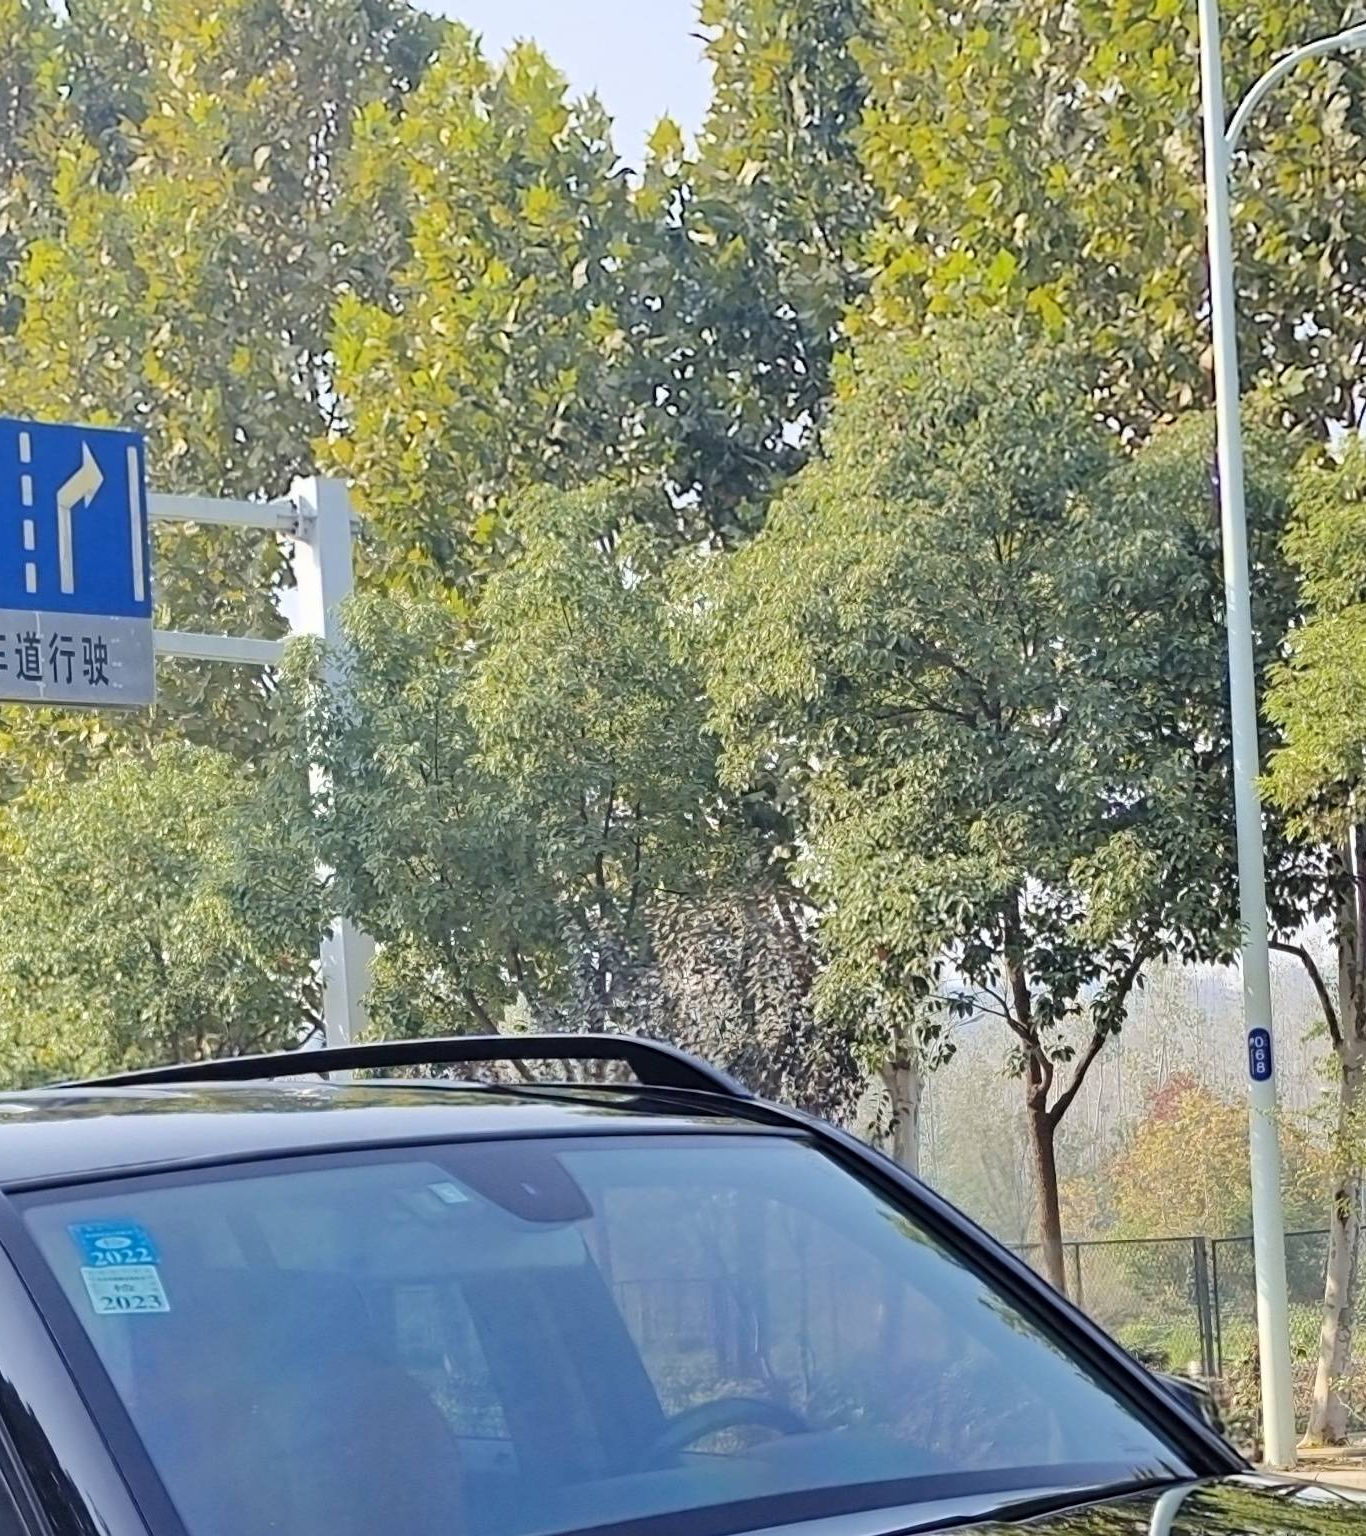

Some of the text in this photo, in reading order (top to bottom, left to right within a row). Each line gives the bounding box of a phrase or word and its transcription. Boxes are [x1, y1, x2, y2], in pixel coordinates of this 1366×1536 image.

[1254, 1036, 1266, 1073] 068
[91, 1247, 153, 1266] 2022
[100, 1295, 162, 1311] 2023
